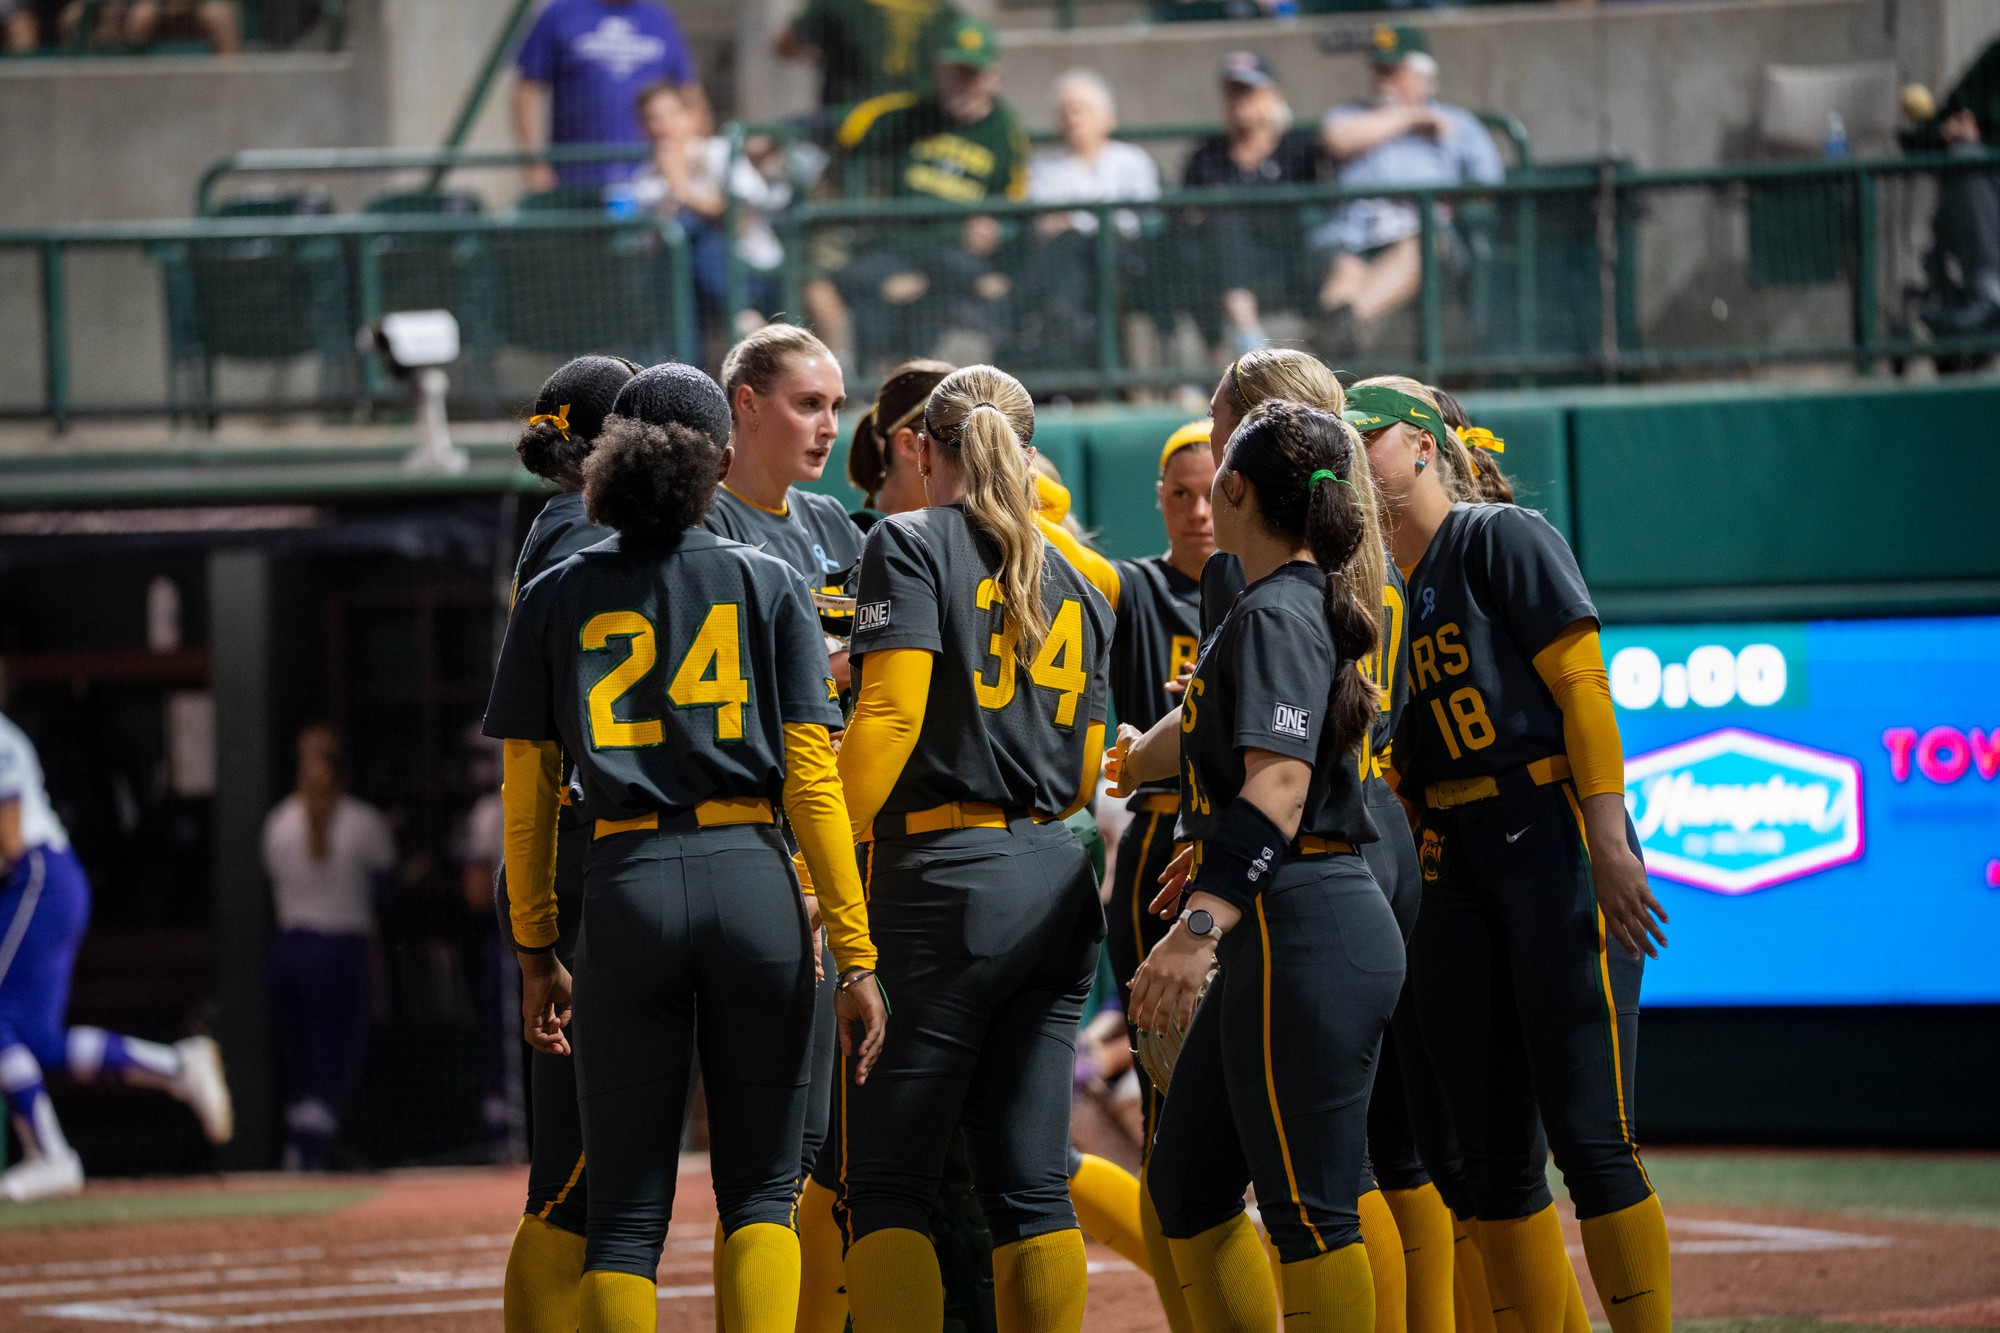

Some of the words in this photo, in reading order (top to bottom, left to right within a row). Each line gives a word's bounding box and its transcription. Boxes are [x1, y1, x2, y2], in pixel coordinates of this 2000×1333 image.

[859, 603, 888, 625] ONE
[580, 601, 750, 749] 24
[973, 577, 1087, 727] 34
[1408, 622, 1469, 696] RS
[1275, 706, 1308, 731] ONE
[1430, 686, 1496, 760] 18
